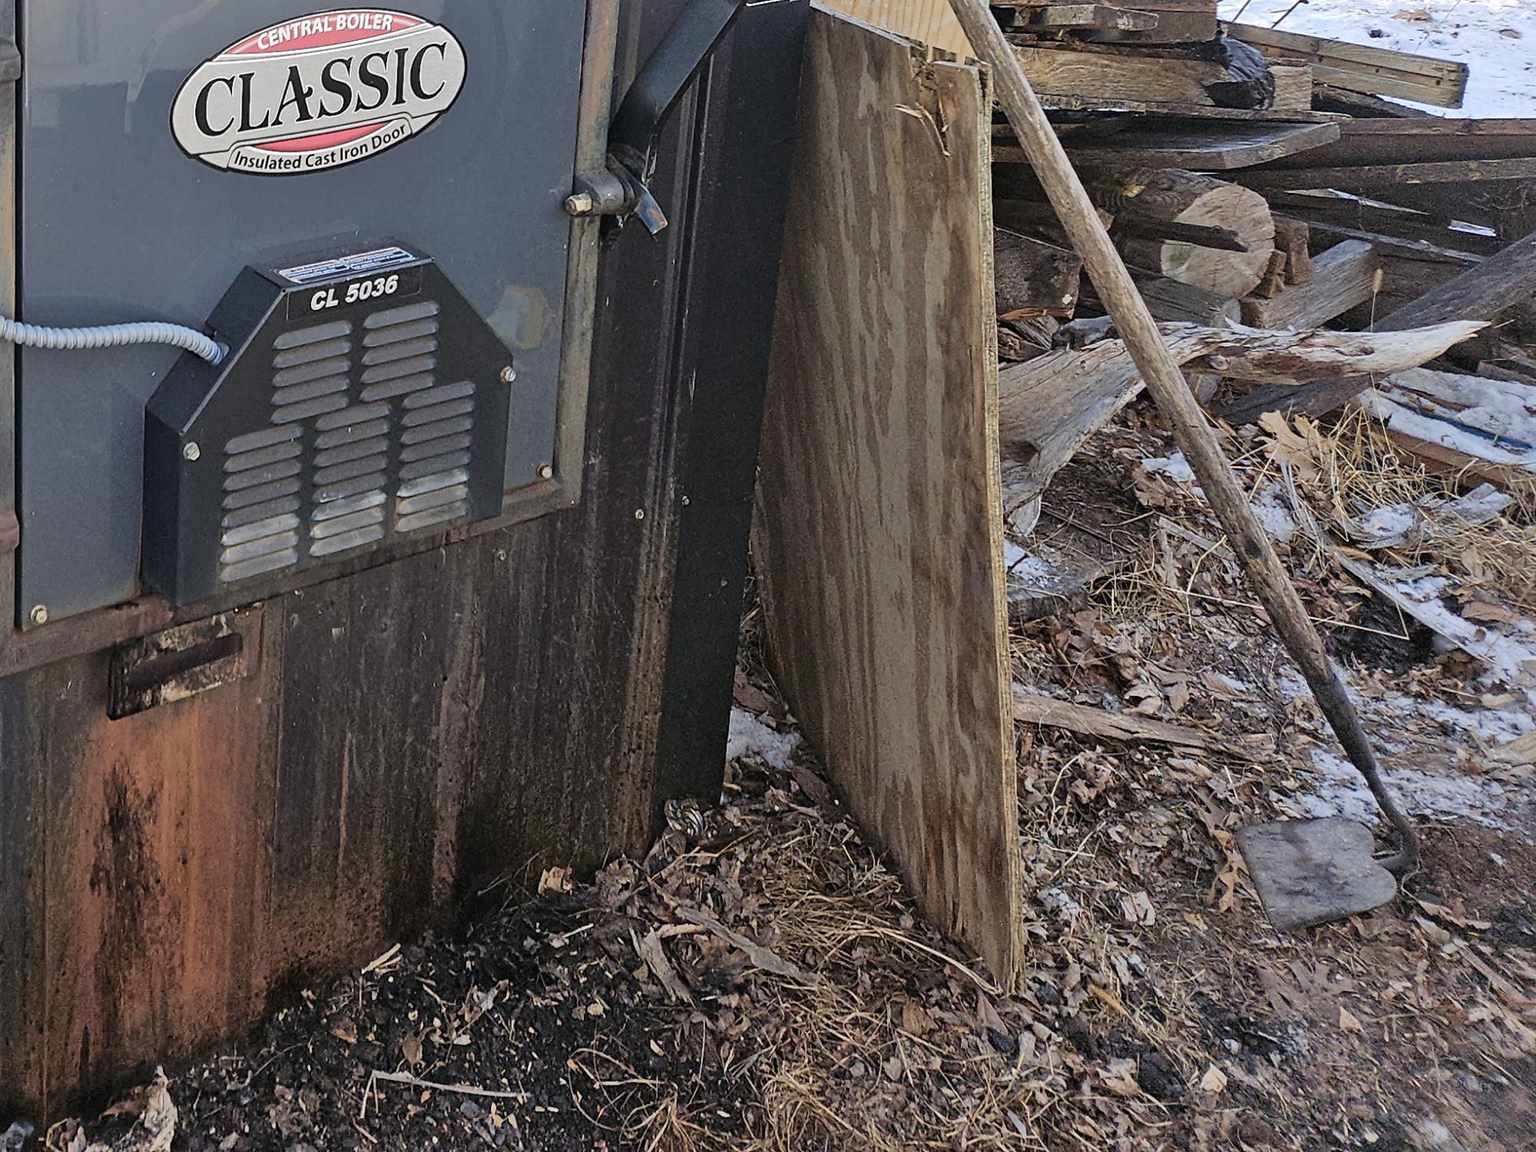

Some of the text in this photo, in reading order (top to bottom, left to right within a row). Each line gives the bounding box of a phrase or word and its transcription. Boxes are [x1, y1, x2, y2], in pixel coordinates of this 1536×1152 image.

[257, 13, 394, 50] CENTRAL BOILER
[195, 42, 447, 137] CLASSIC
[234, 123, 406, 170] Insulated Cast Iron Door
[310, 274, 400, 311] CL 5036
